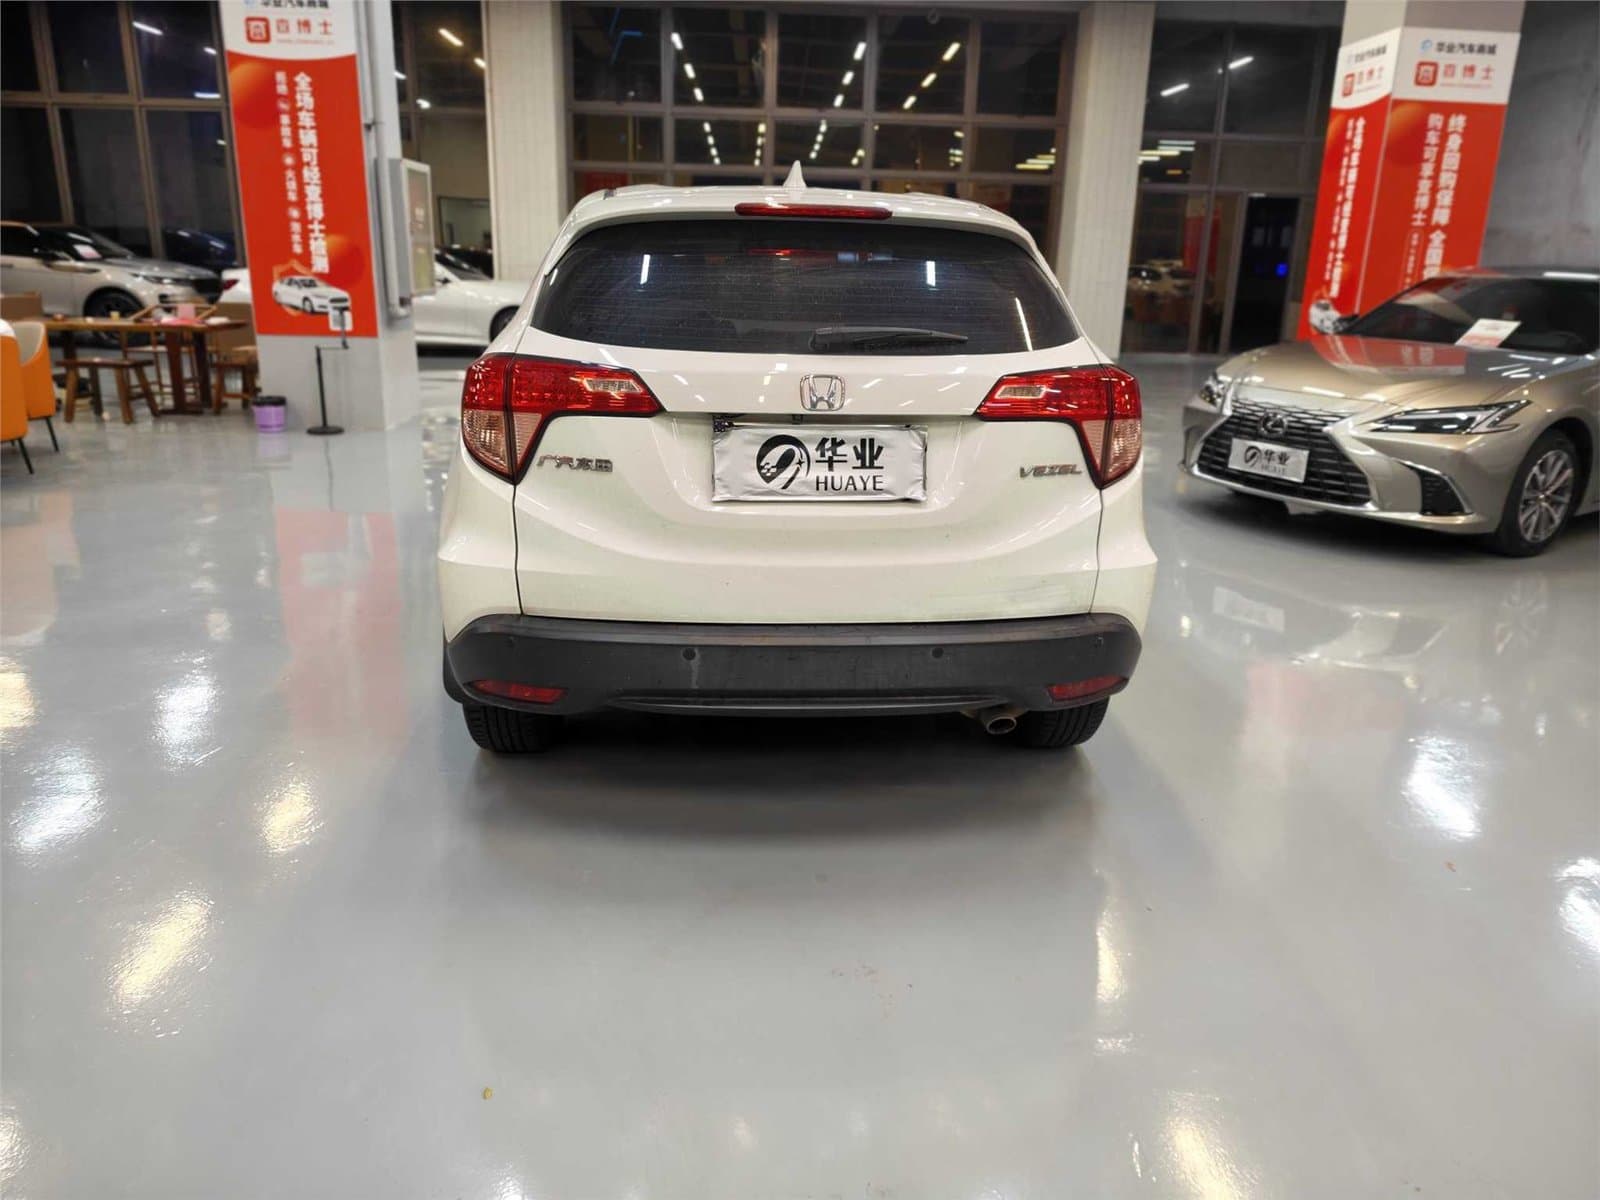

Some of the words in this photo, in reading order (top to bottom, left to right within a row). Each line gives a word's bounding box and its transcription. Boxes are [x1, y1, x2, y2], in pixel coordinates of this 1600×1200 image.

[1430, 112, 1467, 226] 终身回购保障
[815, 437, 884, 472] 华业
[815, 475, 884, 491] HUAYE
[1019, 463, 1083, 478] VEZEL
